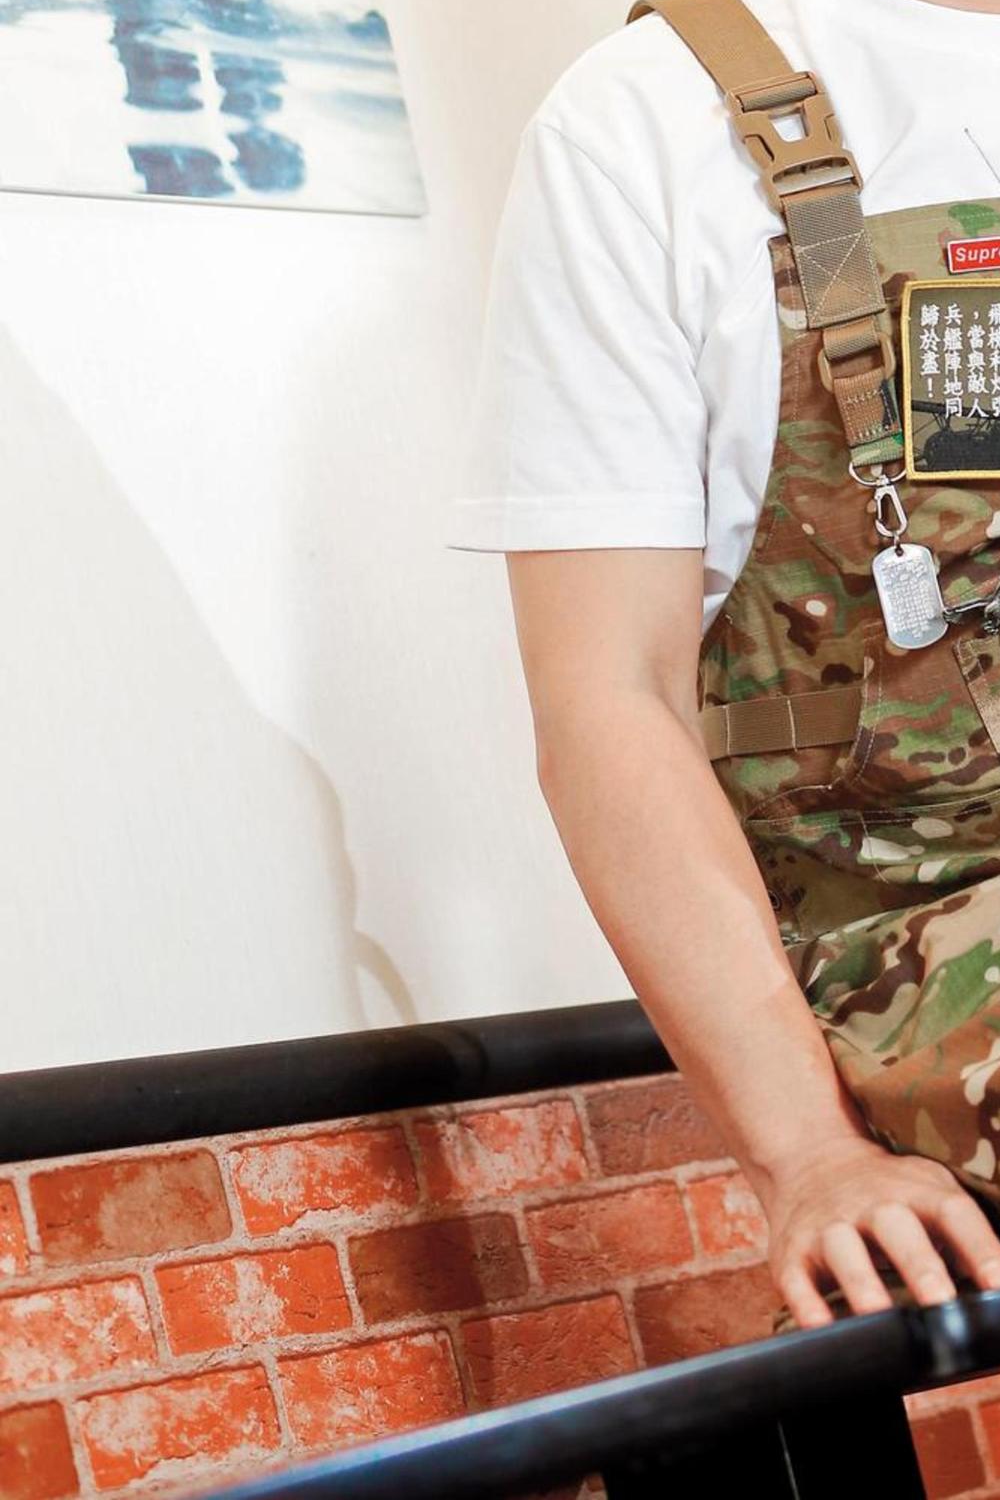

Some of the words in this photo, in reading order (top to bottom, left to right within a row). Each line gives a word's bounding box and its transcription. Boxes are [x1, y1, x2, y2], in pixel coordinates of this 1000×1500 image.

[943, 303, 964, 420] 兵艦陣地同
